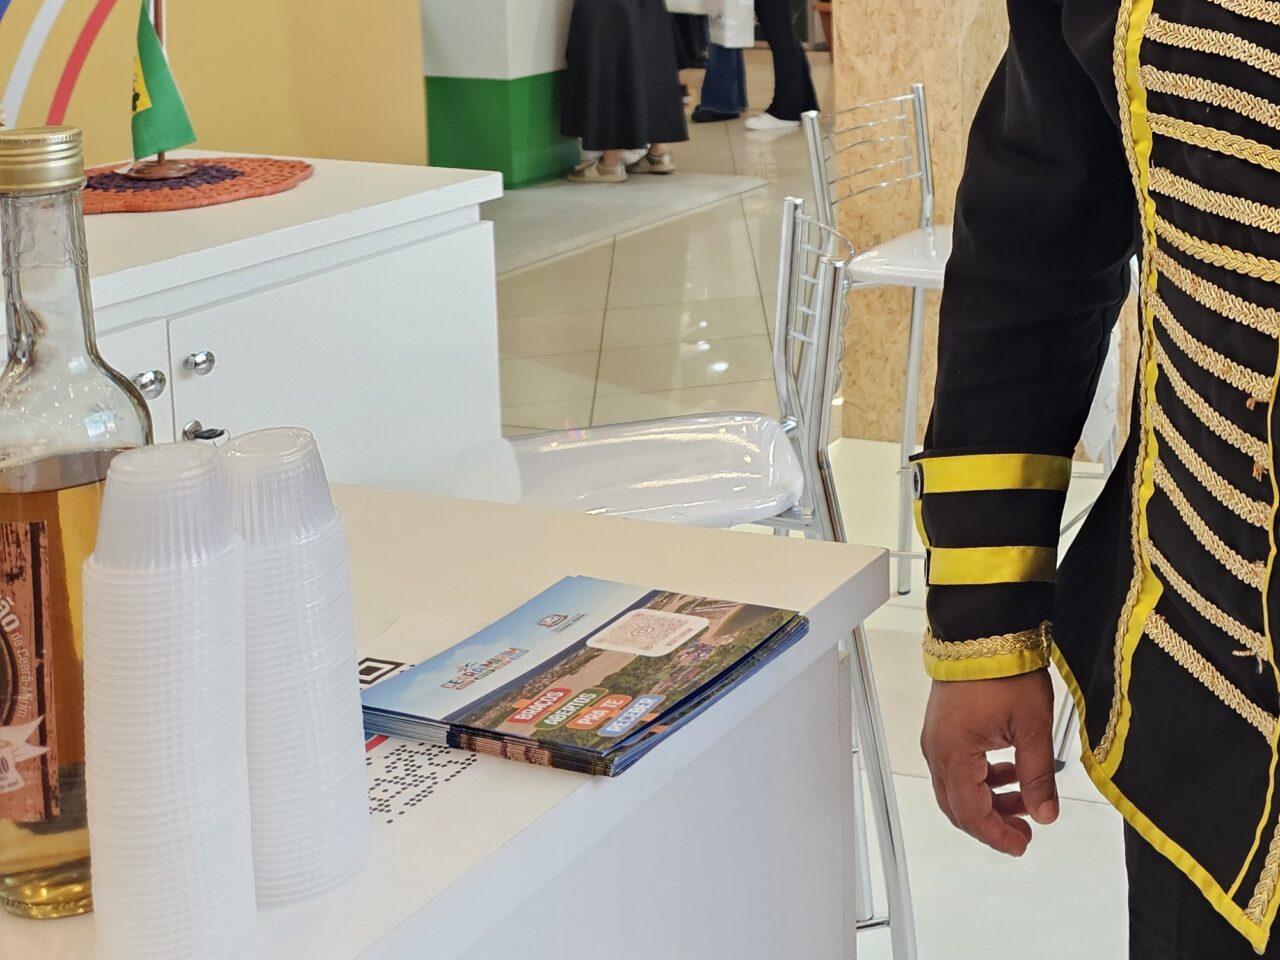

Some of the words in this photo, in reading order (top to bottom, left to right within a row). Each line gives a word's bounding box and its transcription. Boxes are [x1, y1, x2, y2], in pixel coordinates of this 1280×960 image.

[514, 691, 564, 721] BRAÇOS
[543, 692, 598, 726] ABERTOS
[576, 707, 610, 726] PRA
[603, 698, 625, 709] TE
[607, 697, 658, 732] RECEBER
